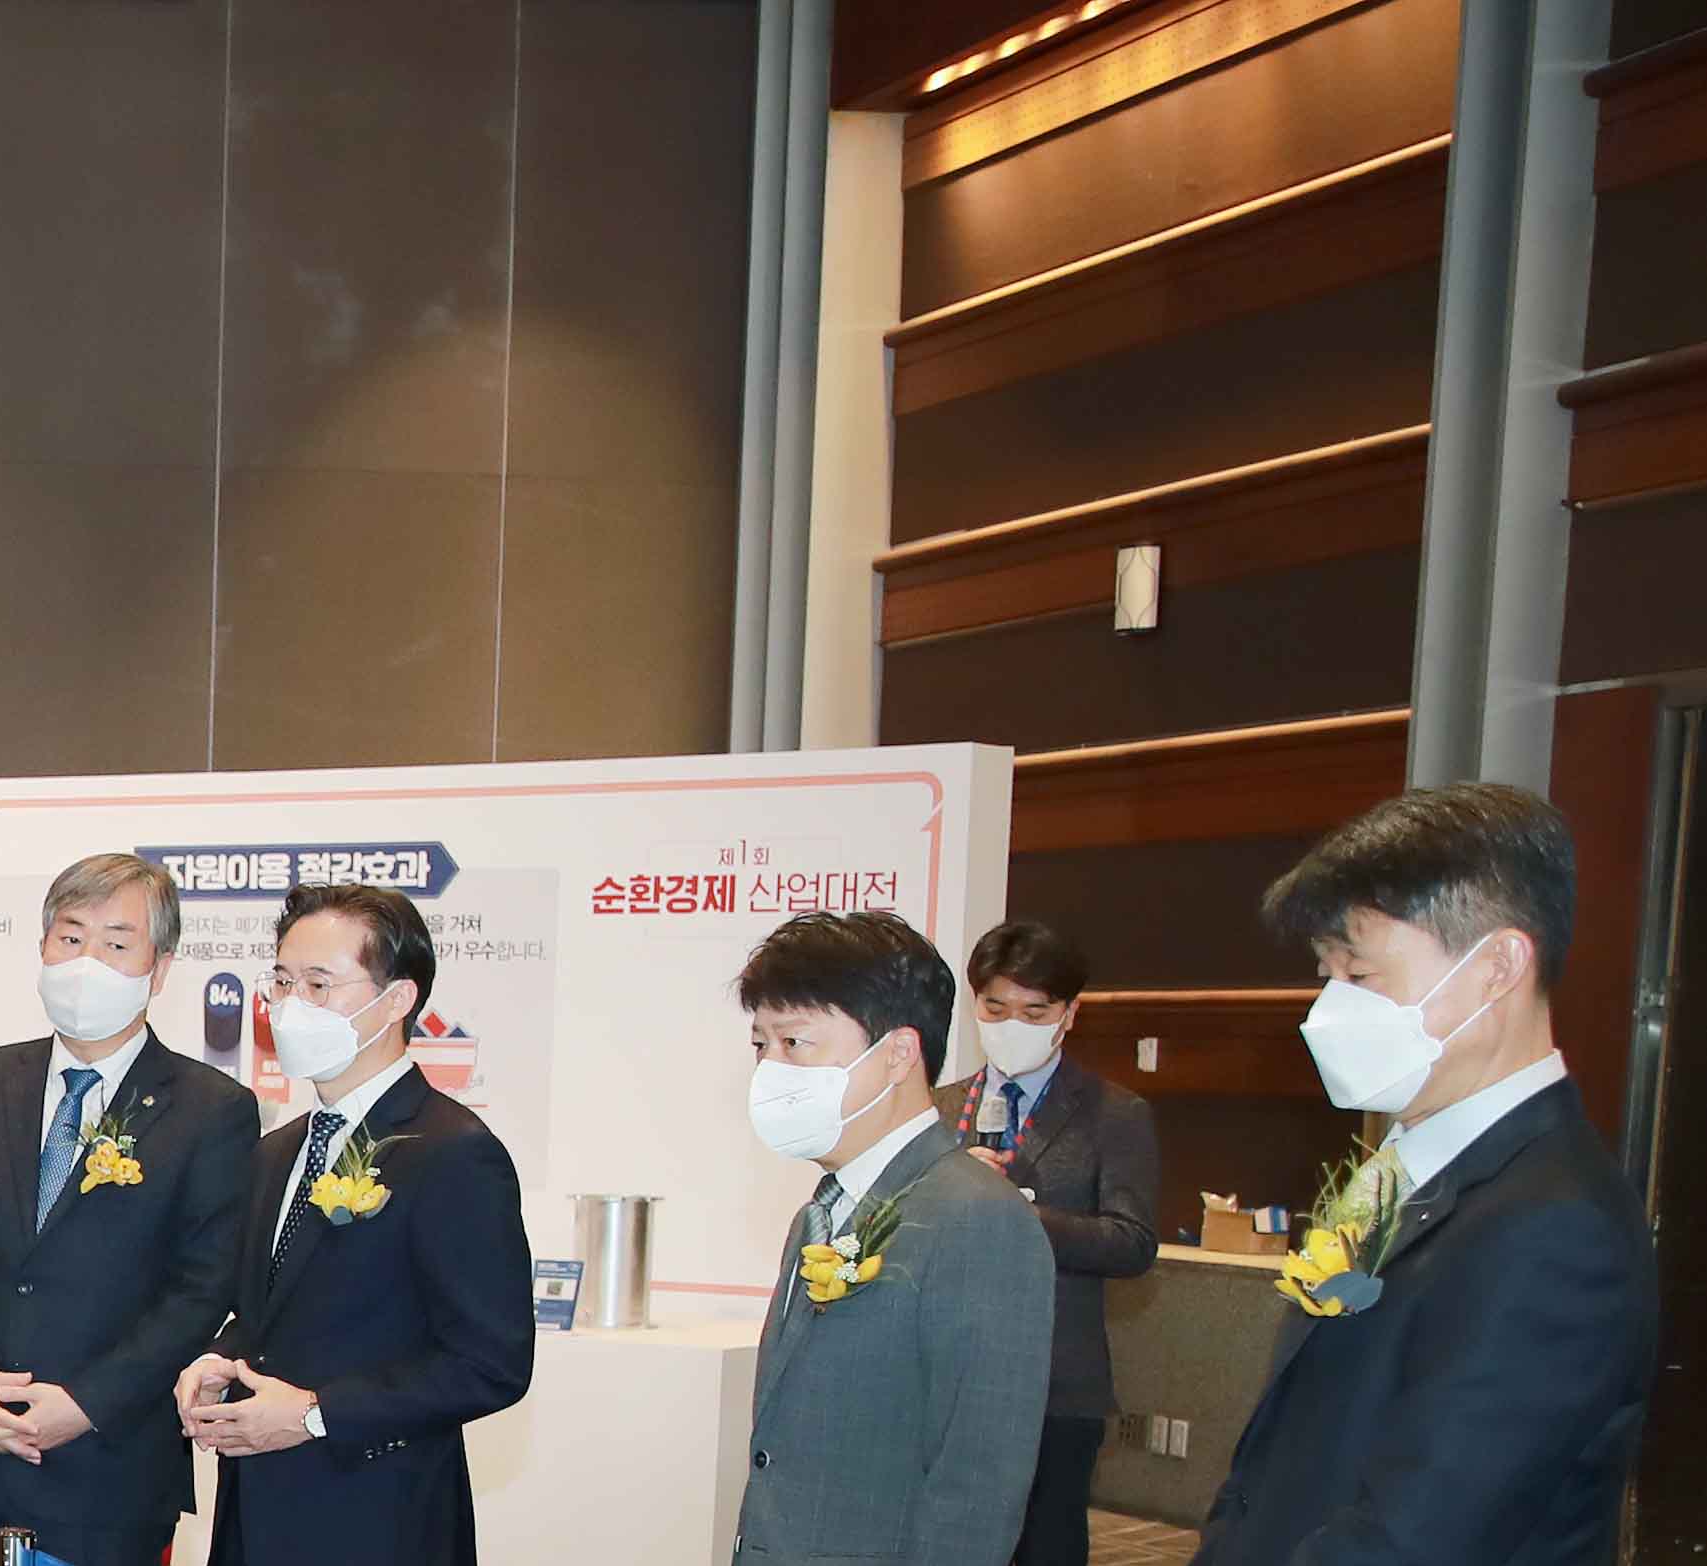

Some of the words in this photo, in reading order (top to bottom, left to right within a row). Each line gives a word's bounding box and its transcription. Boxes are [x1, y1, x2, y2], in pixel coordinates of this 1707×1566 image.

[162, 852, 291, 891] 자원이용
[298, 850, 431, 889] 절감효과
[592, 873, 736, 914] 순환경제
[749, 870, 897, 913] 산업대전
